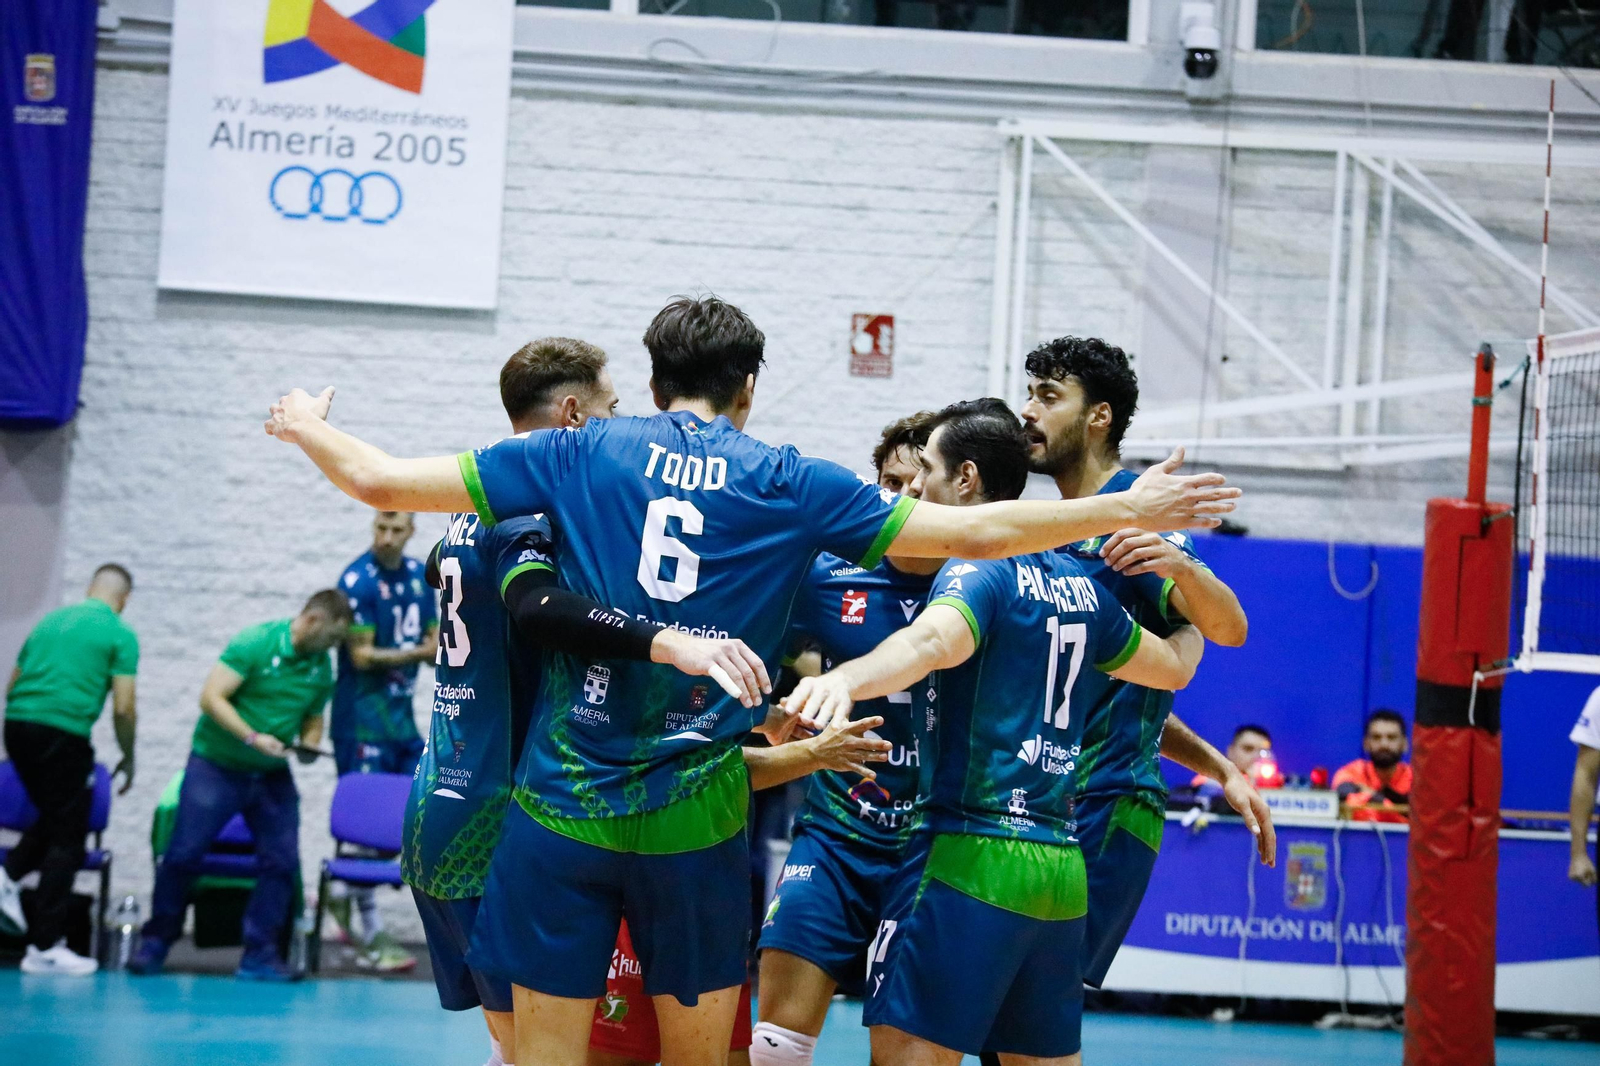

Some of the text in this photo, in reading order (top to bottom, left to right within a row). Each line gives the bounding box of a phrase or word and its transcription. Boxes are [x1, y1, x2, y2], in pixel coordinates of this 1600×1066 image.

[212, 96, 468, 130] XV Juegos Mediterráneos
[209, 121, 467, 166] Almería 2005
[644, 442, 728, 491] TODD
[637, 496, 704, 603] 6
[392, 602, 421, 645] 14
[435, 557, 472, 667] 3
[588, 608, 626, 629] KIPSTA
[636, 613, 730, 640] dación
[841, 615, 864, 625] SVM
[1043, 615, 1087, 730] 17
[571, 704, 610, 724] ALMERÍA
[665, 720, 678, 730] DE
[1165, 912, 1304, 940] DIPUTACIÓN
